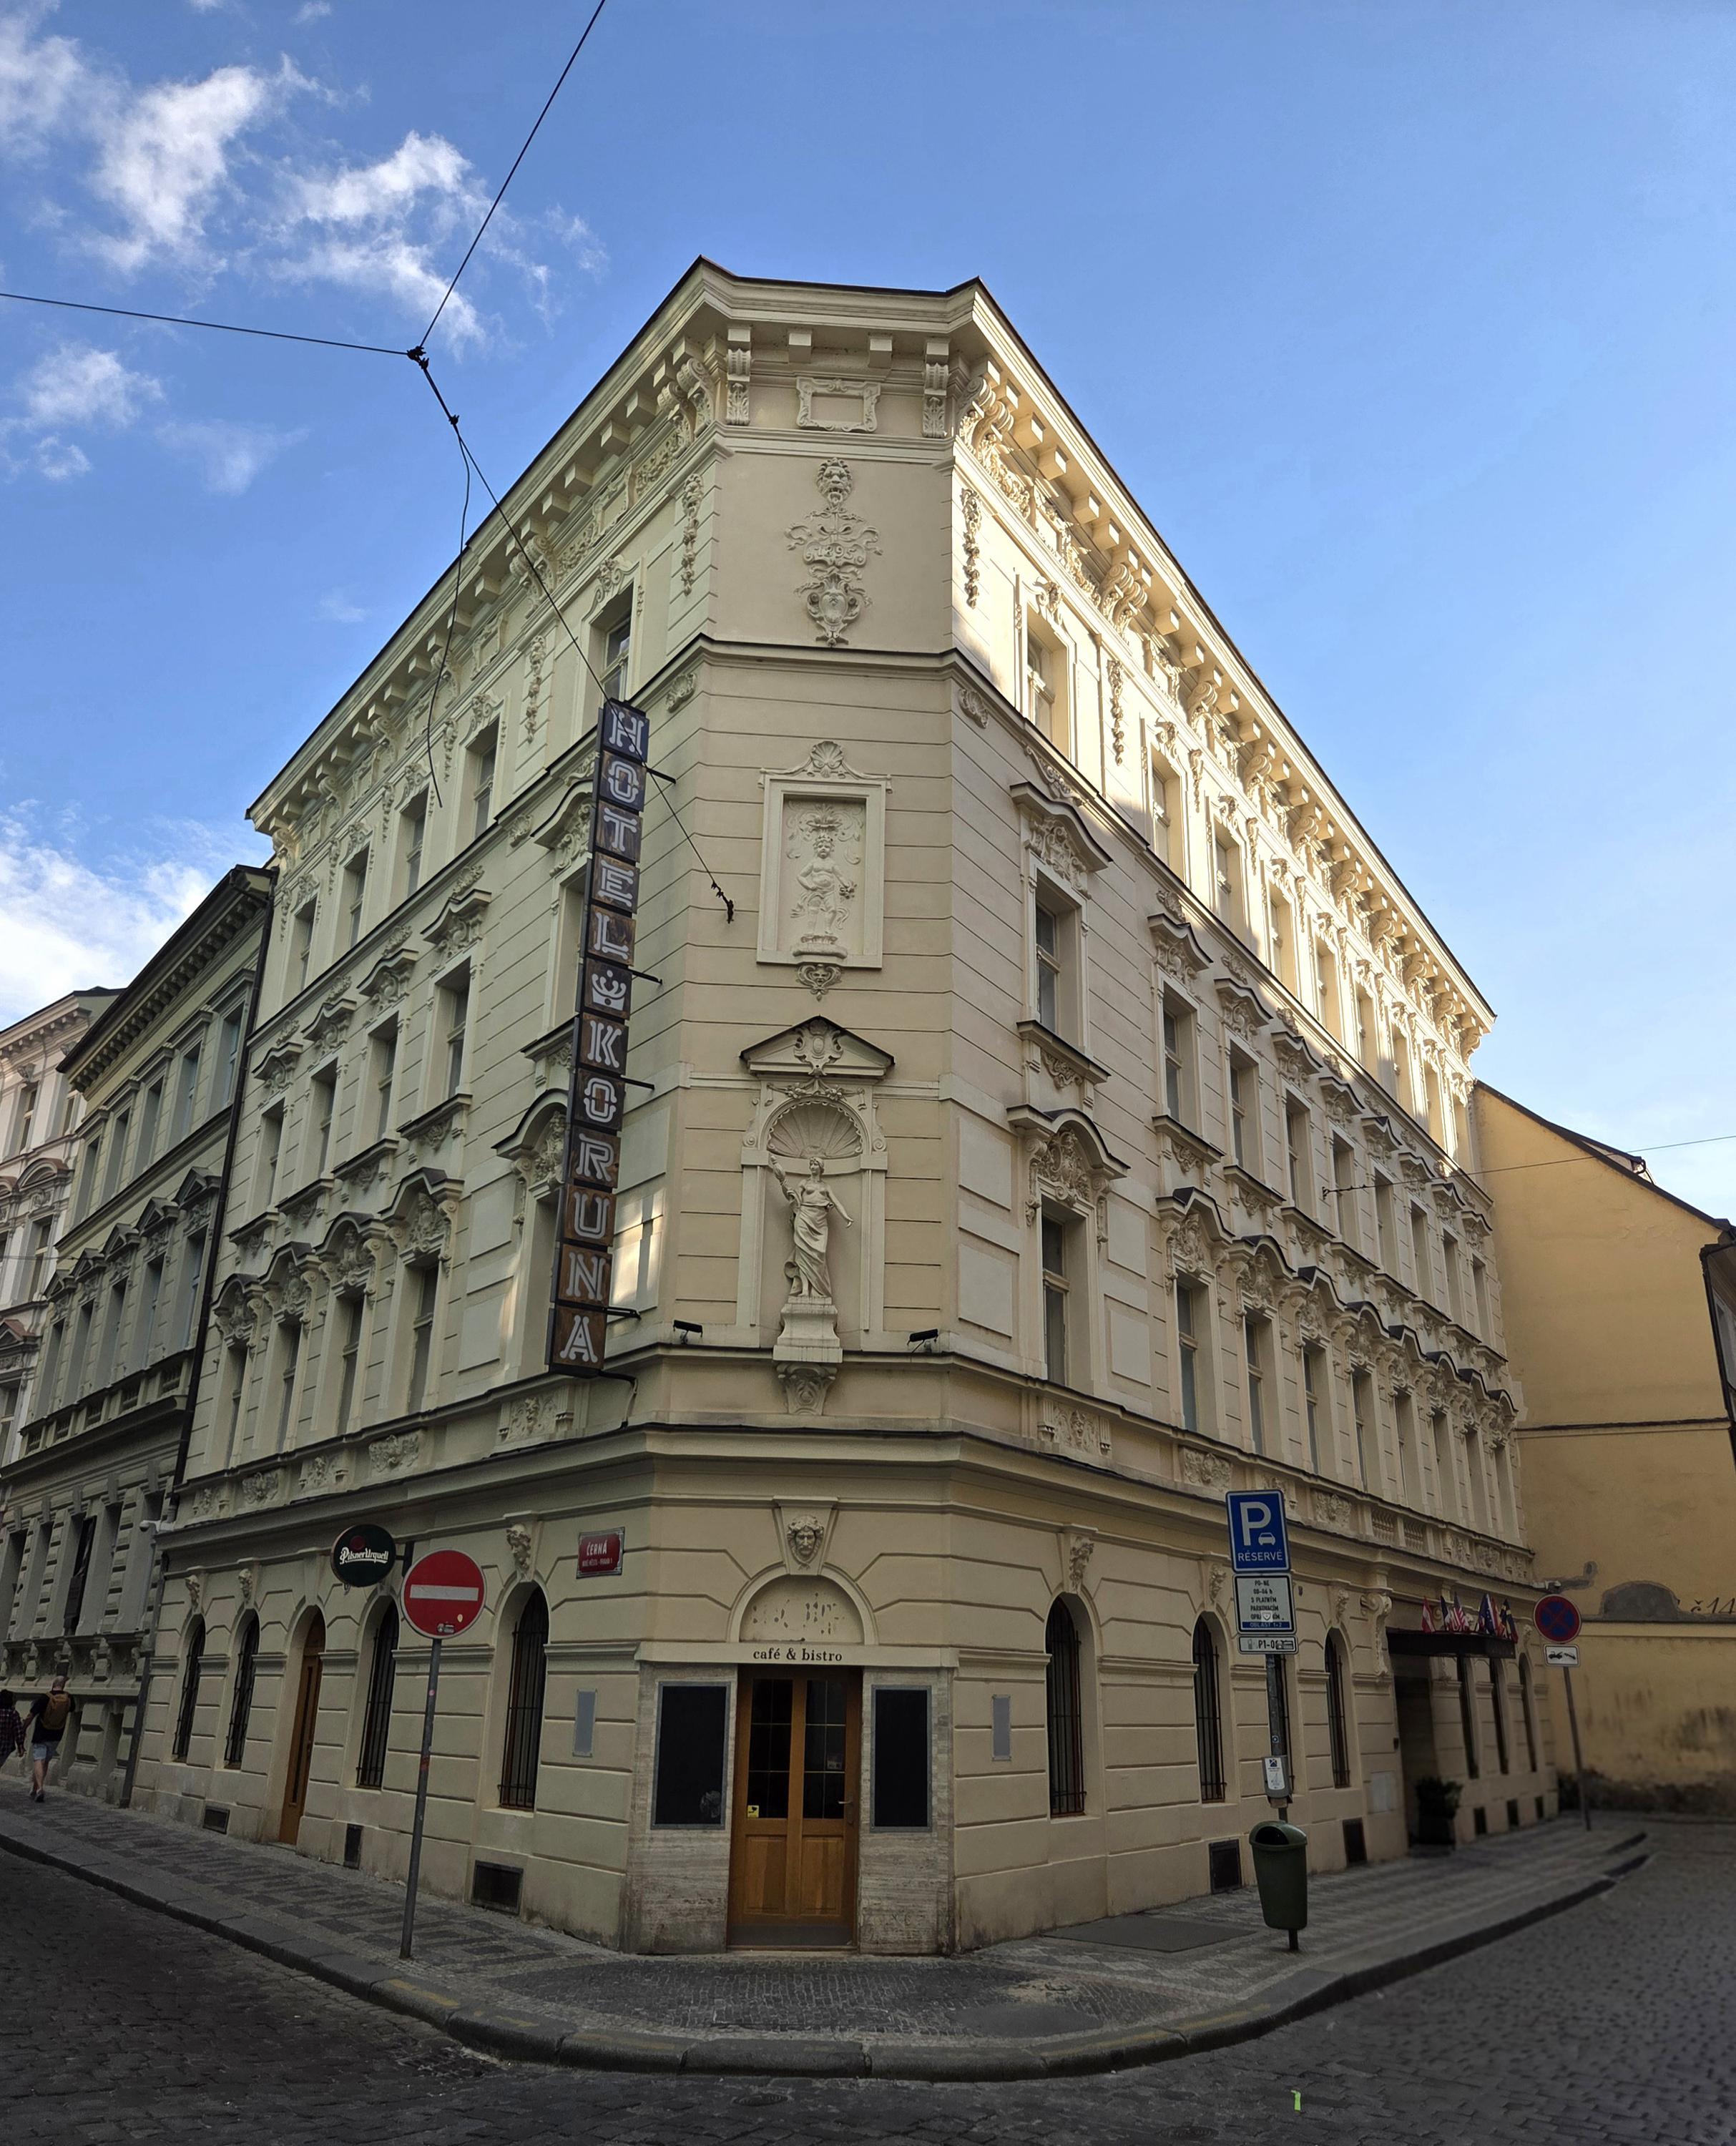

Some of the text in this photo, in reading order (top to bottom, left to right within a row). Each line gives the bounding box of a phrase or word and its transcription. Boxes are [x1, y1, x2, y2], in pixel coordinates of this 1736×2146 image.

[560, 711, 644, 1363] HOTEL KORUNA
[1240, 1501, 1271, 1546] P
[339, 1547, 389, 1565] Pilsner Urquell
[587, 1539, 608, 1556] ČERNÁ
[1237, 1549, 1283, 1562] RÉSERVÉ
[752, 1647, 843, 1661] café & bistro
